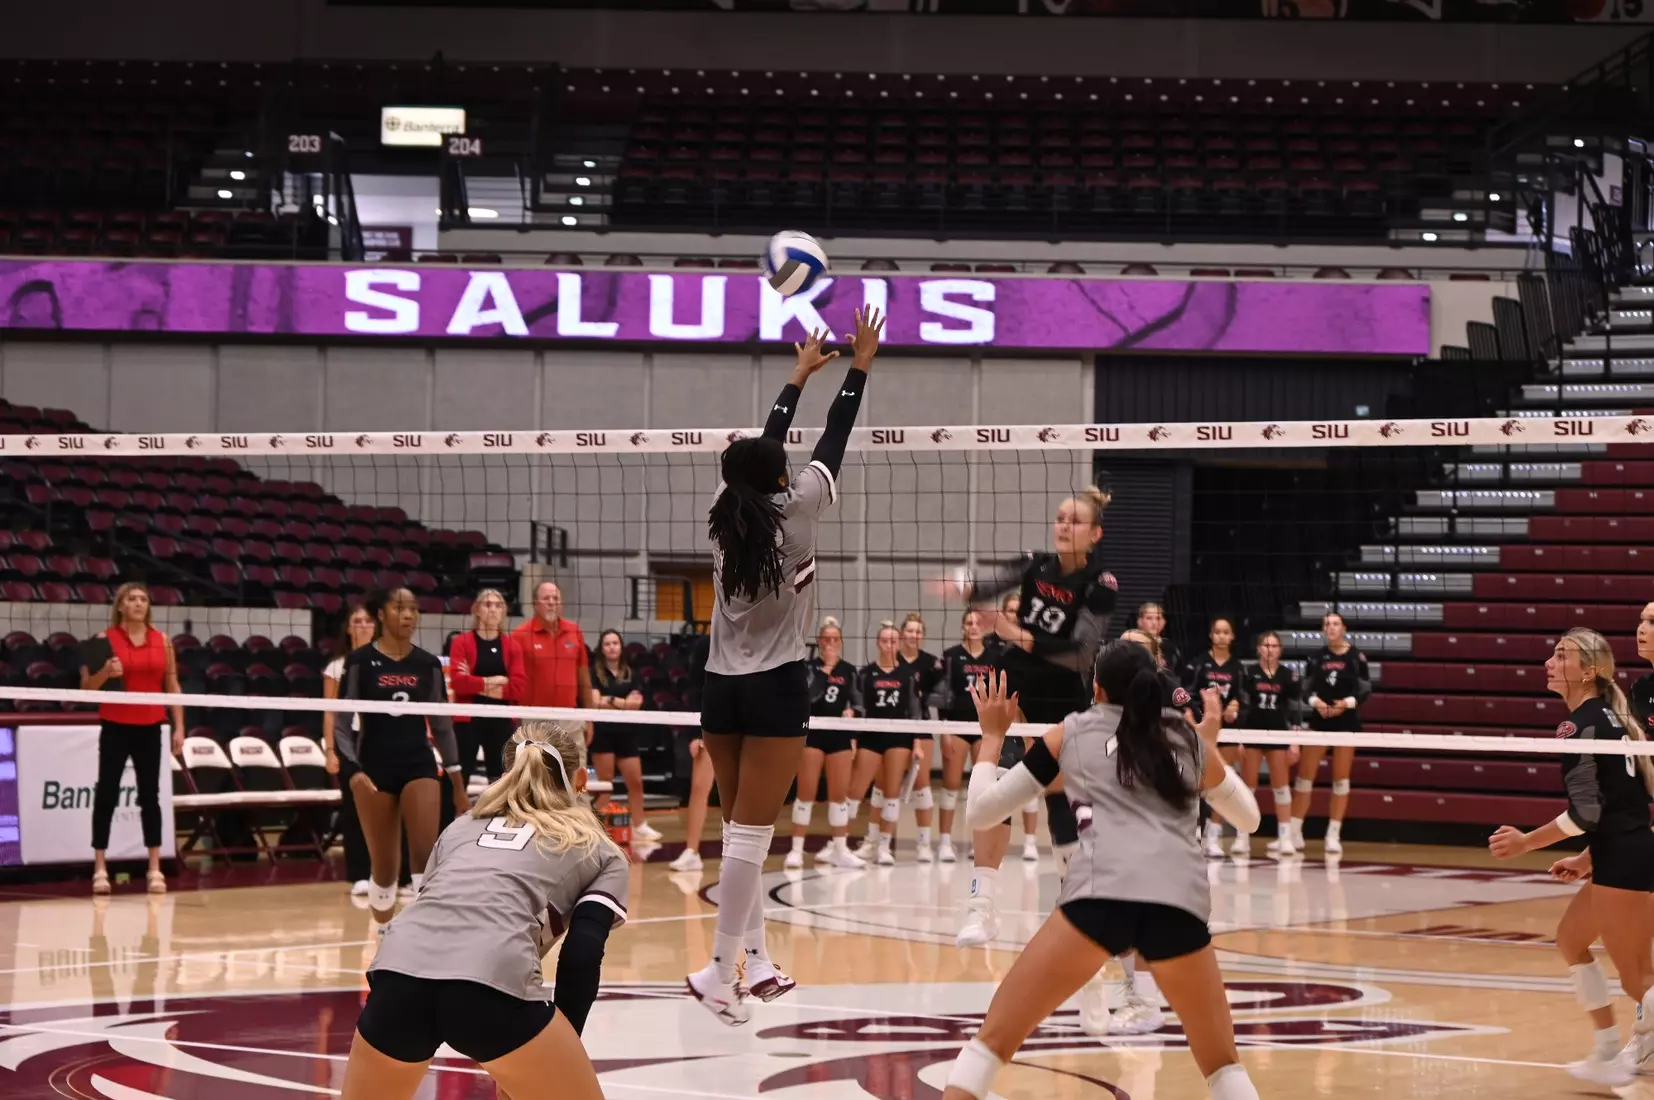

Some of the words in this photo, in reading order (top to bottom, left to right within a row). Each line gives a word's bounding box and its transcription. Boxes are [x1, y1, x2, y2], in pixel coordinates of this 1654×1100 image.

[288, 135, 321, 152] 203
[449, 138, 481, 155] 204
[344, 270, 996, 345] SALUKIS
[58, 437, 85, 450] SIU
[138, 437, 165, 449] SIU
[220, 436, 248, 449] SIU
[305, 436, 334, 448] SIU
[393, 435, 421, 447] SIU
[483, 434, 512, 447] SIU
[575, 433, 606, 446] SIU
[671, 432, 702, 445] SIU
[871, 430, 905, 444] SIU
[976, 429, 1010, 443] SIU
[1084, 428, 1119, 442] SIU
[1196, 426, 1232, 441] SIU
[1311, 424, 1349, 439] SIU
[1430, 422, 1470, 437] SIU
[1553, 420, 1594, 436] SIU
[1023, 597, 1066, 634] 19
[377, 674, 418, 688] SEMO
[824, 685, 840, 703] 8
[874, 689, 901, 707] 14
[1258, 692, 1278, 710] 11
[476, 816, 537, 851] 9
